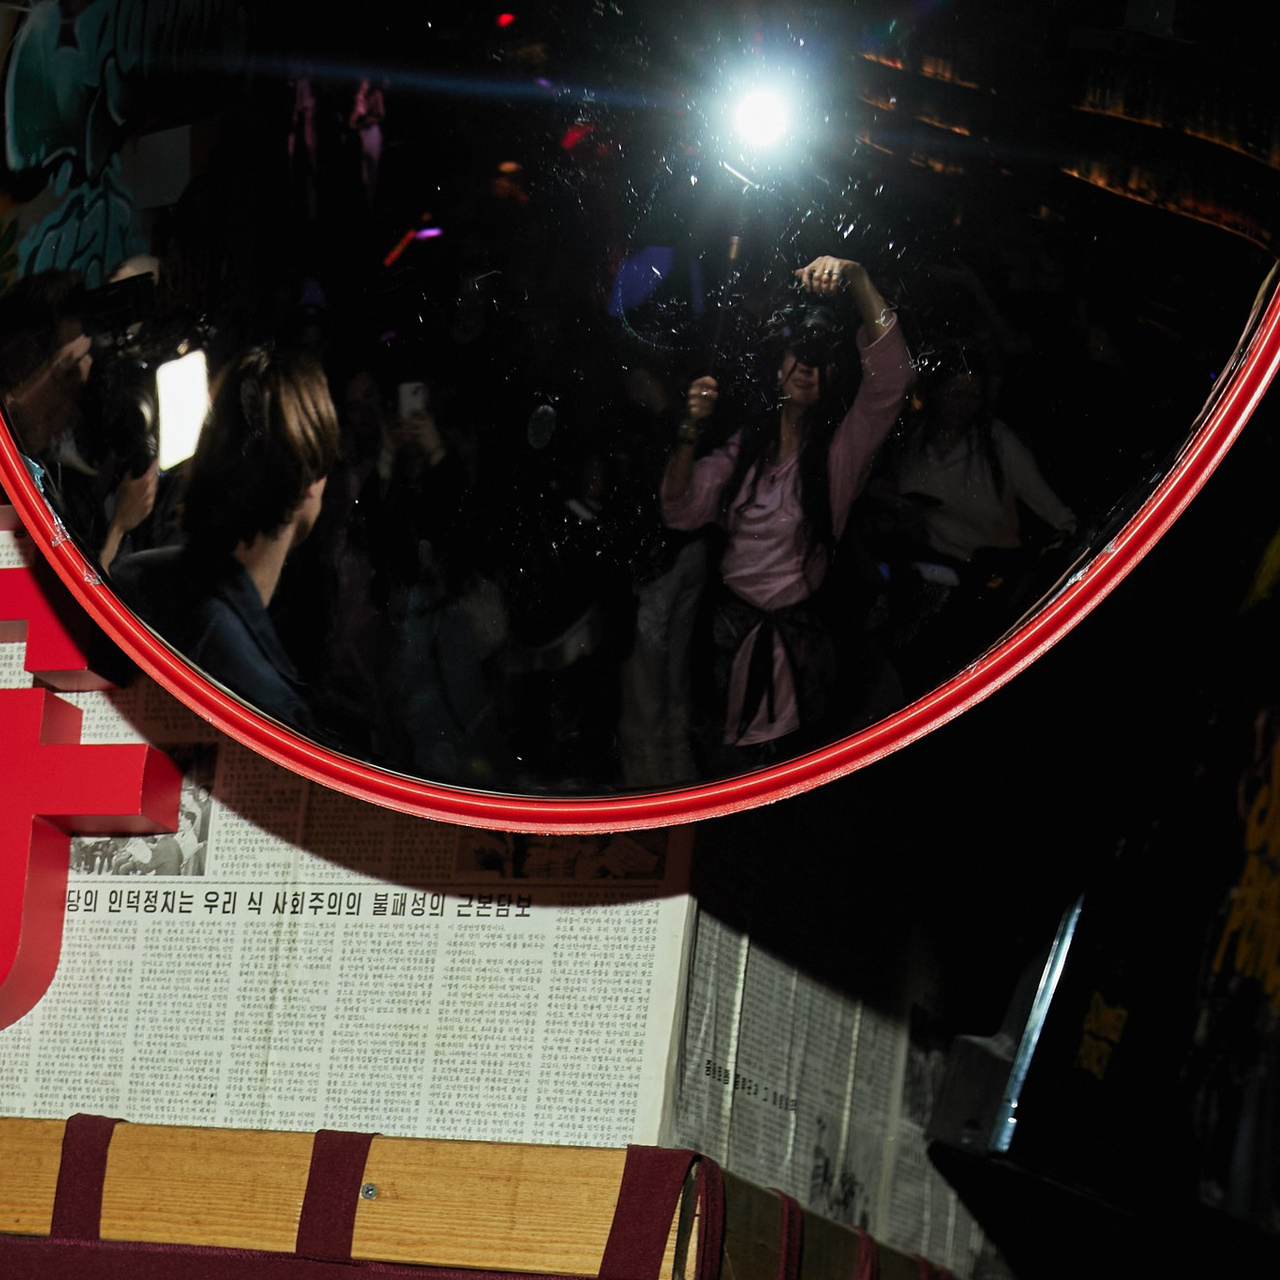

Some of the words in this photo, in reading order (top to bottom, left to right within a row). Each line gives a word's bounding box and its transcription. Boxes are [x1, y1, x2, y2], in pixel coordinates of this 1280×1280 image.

[67, 889, 98, 914] 당의
[107, 889, 195, 915] 인덕정치는
[203, 890, 237, 916] 우리
[246, 890, 263, 916] 식
[271, 890, 362, 917] 사회주의의
[372, 891, 445, 918] 불패성의
[456, 892, 532, 919] 근본담보
